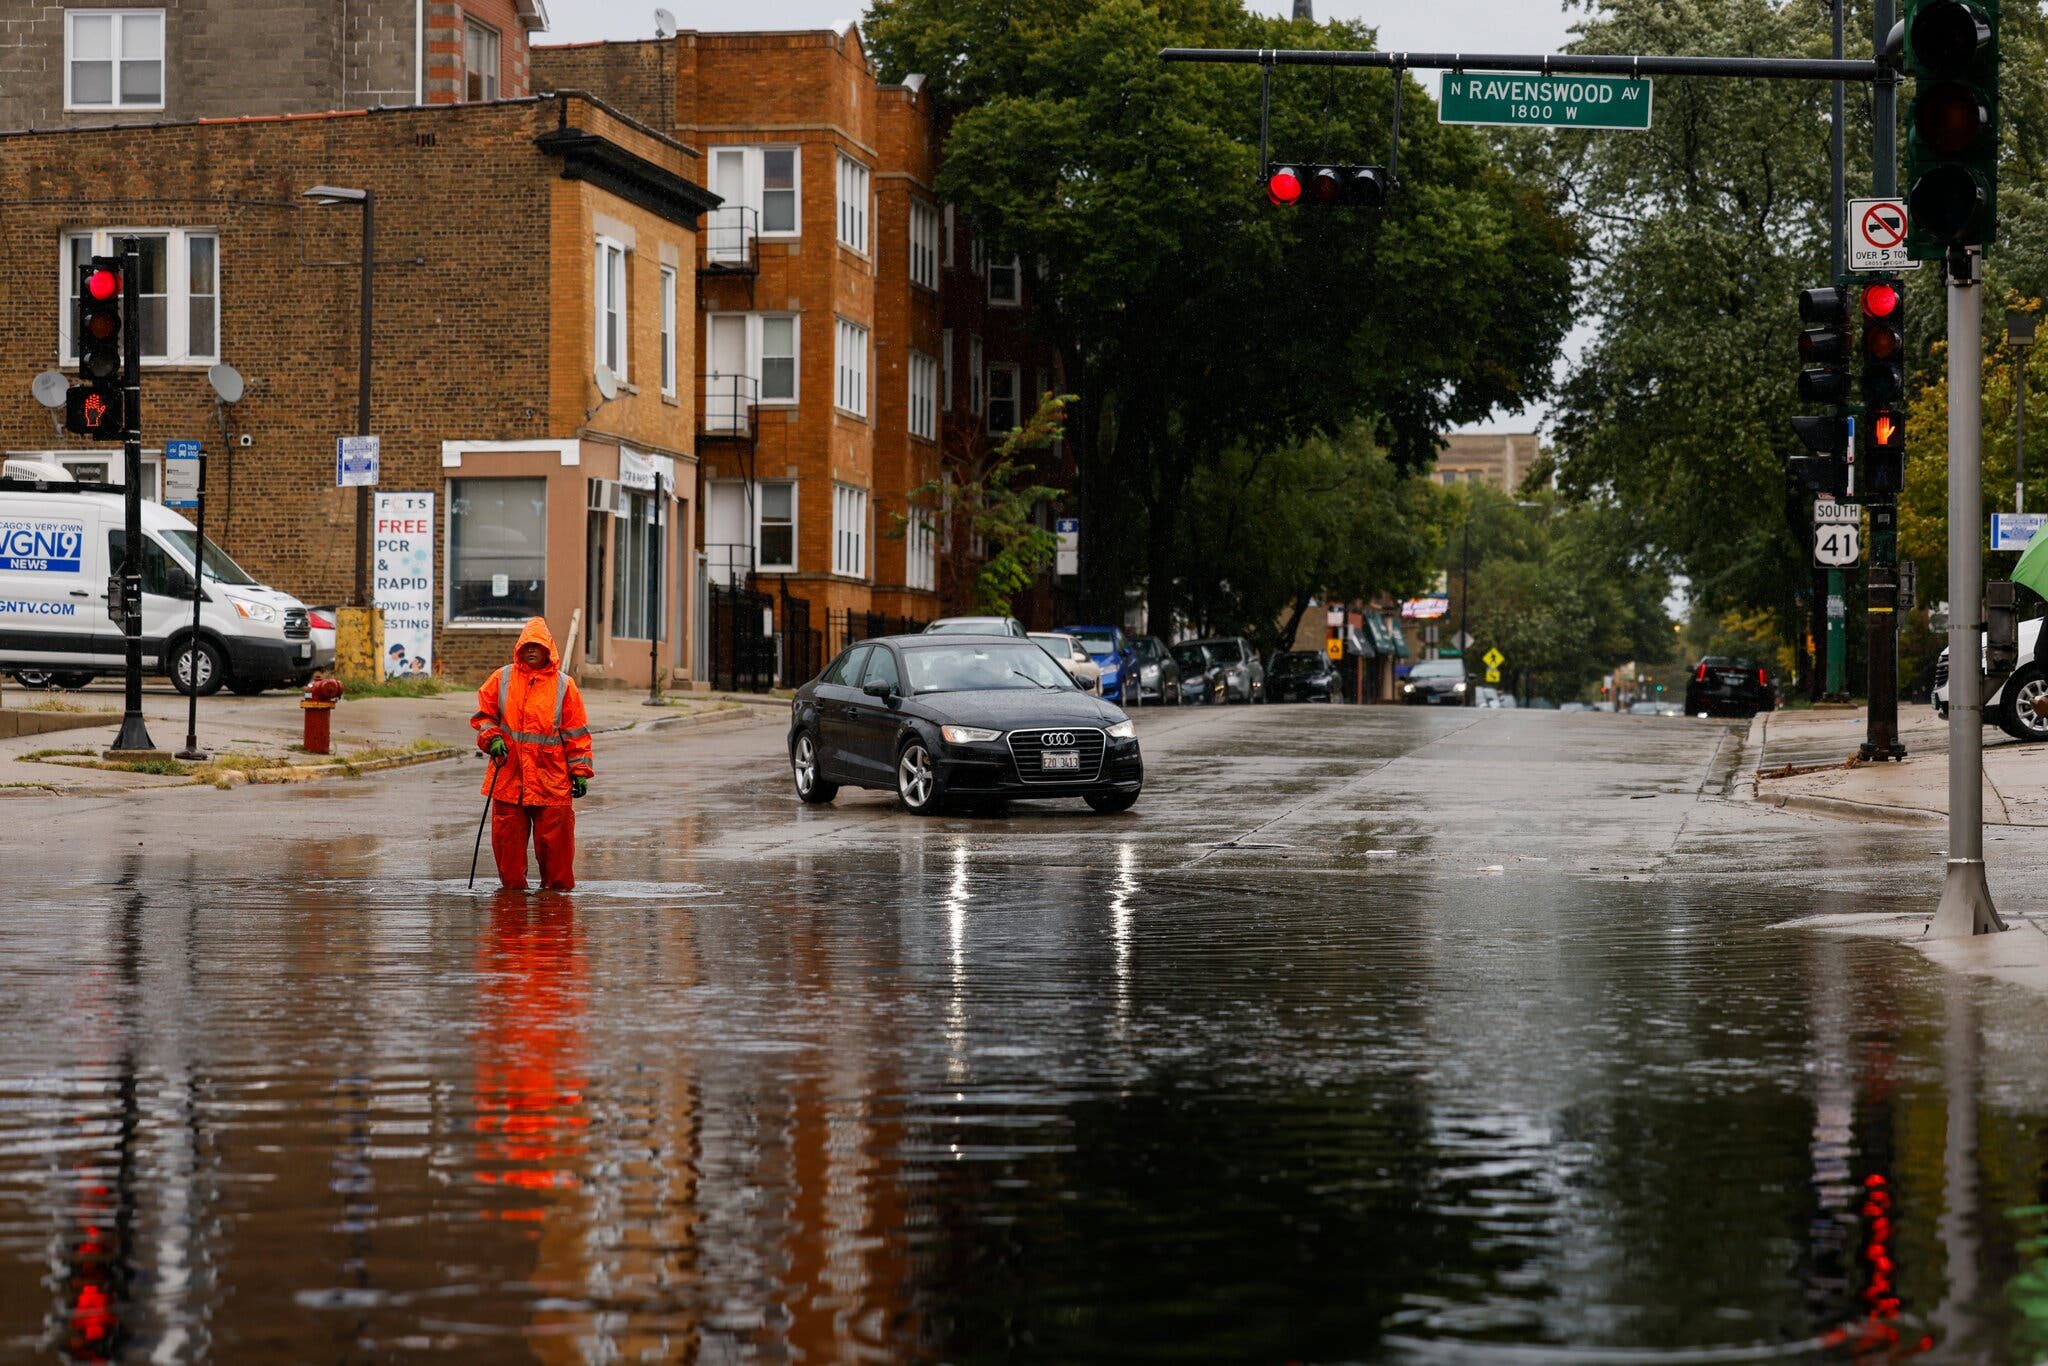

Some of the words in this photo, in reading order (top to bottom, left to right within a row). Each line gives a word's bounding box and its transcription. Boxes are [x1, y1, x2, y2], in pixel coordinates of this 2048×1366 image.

[1451, 82, 1461, 96] N
[1469, 80, 1613, 104] RAVENSWOOD
[1621, 87, 1640, 100] AV
[1511, 105, 1553, 119] 1800
[1566, 106, 1578, 120] W
[1855, 251, 1878, 260] OVER
[1880, 249, 1890, 261] 5
[1893, 250, 1908, 259] TON
[1817, 504, 1858, 518] SOUTH
[35, 522, 58, 531] VERY
[60, 523, 83, 532] OWN
[378, 519, 428, 534] FREE
[377, 540, 410, 552] PCR
[1821, 533, 1850, 557] 41
[10, 558, 48, 570] NEWS
[377, 558, 388, 571] &
[377, 577, 428, 590] RAPID
[374, 601, 430, 611] COVID-19
[384, 619, 430, 629] ESTING
